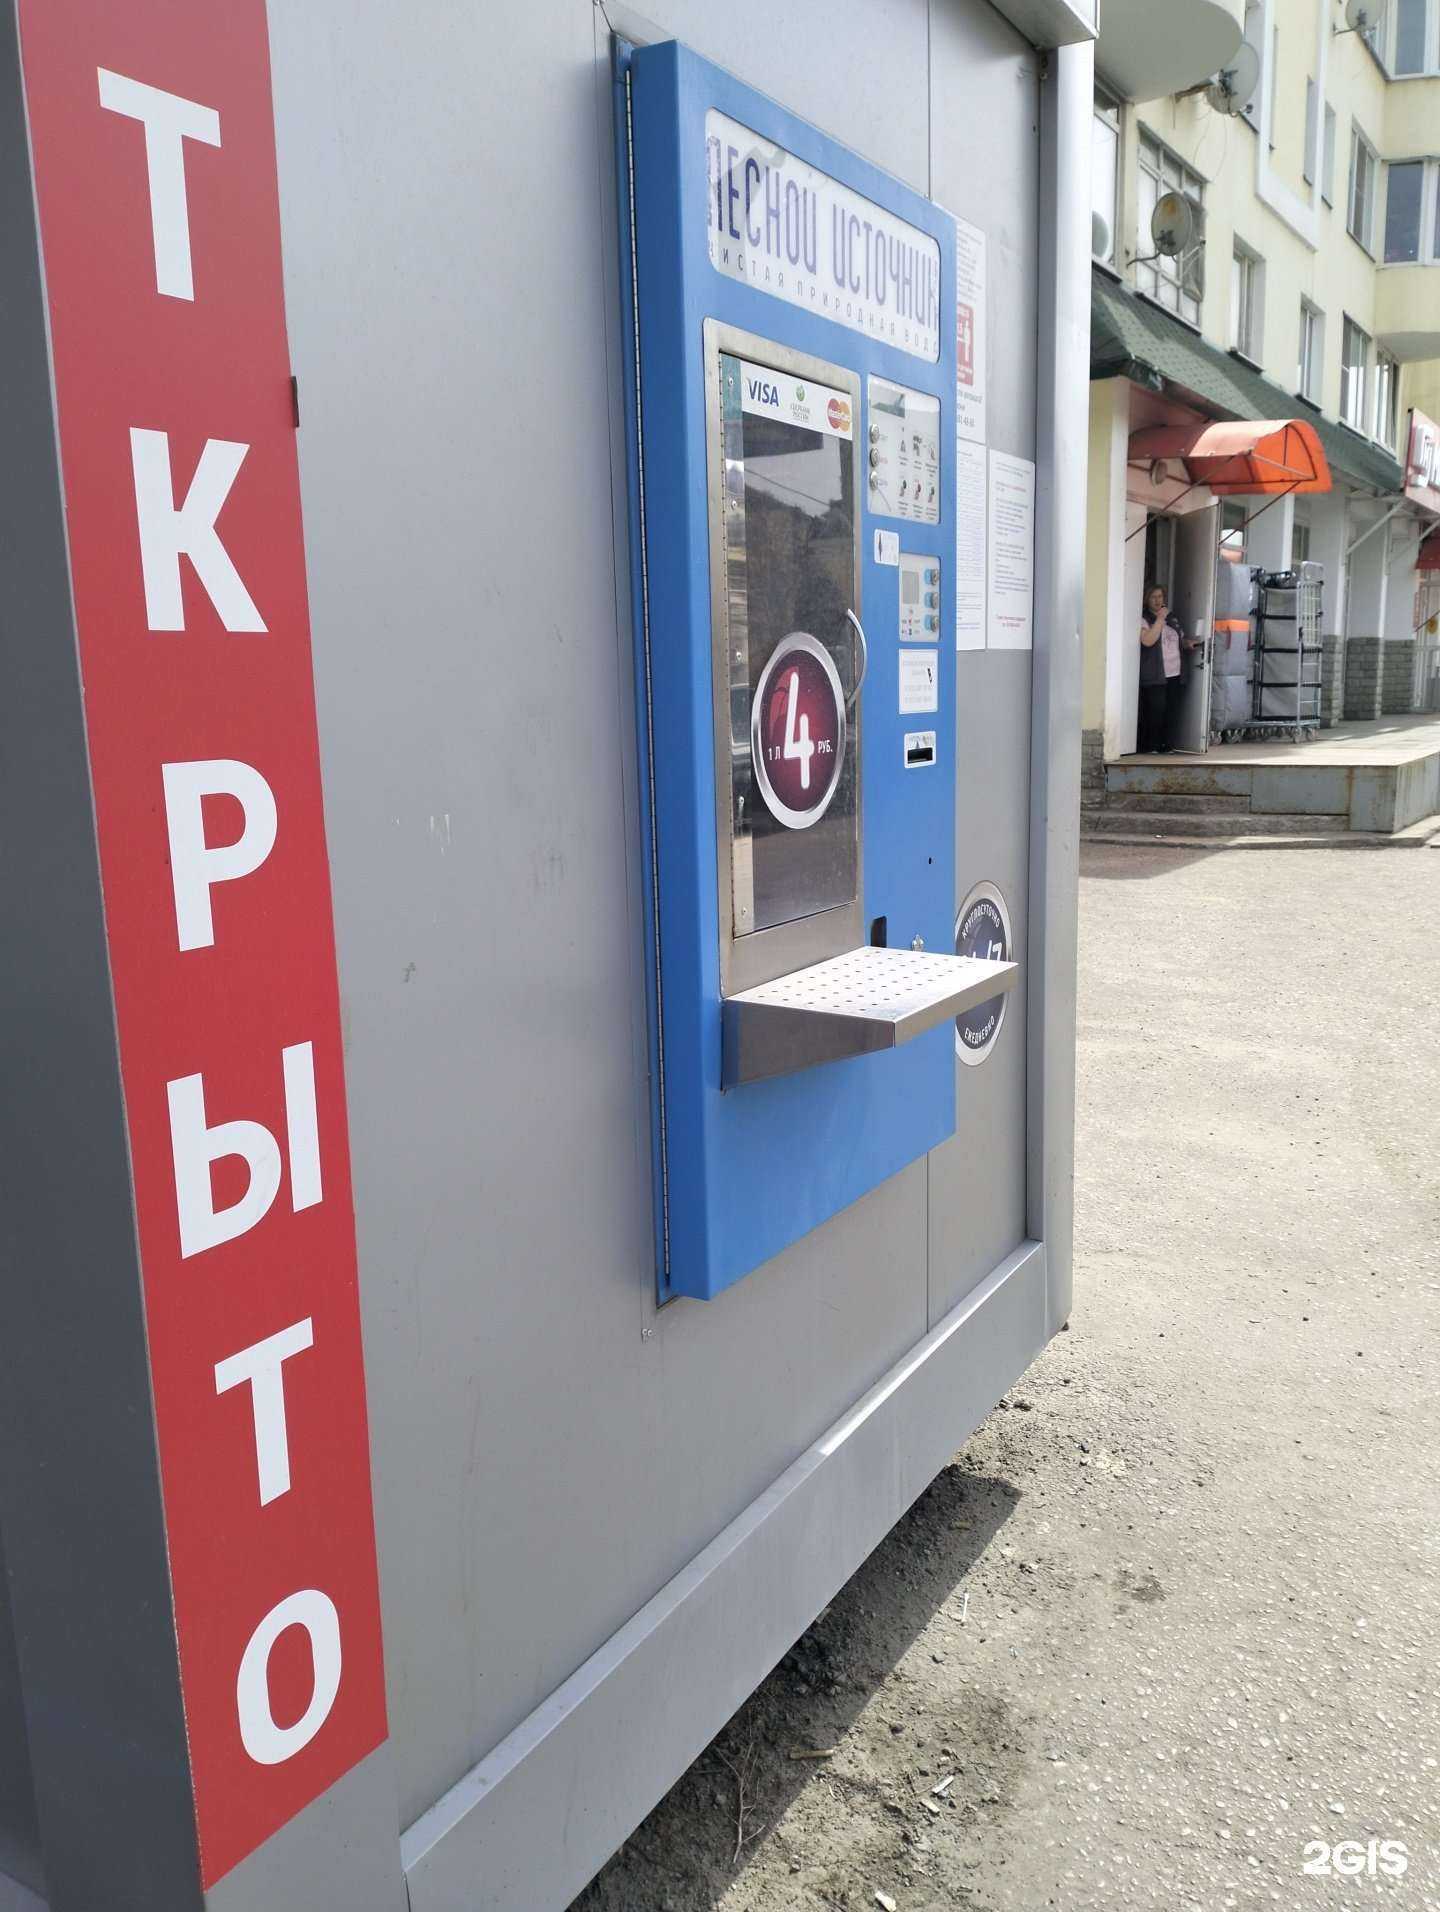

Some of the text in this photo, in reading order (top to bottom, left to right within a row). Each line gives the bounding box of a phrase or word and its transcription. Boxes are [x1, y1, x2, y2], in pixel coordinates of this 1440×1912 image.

[833, 203, 937, 331] ИСТОЧНИК
[797, 280, 896, 336] ПРИРОДНАЯ
[745, 379, 779, 407] VISA
[783, 672, 815, 790] 4
[818, 741, 833, 754] РУБ.
[961, 904, 1000, 940] КРУГЛОСУТОЧНО
[964, 1015, 995, 1045] ЕЖЕДНЕВНО
